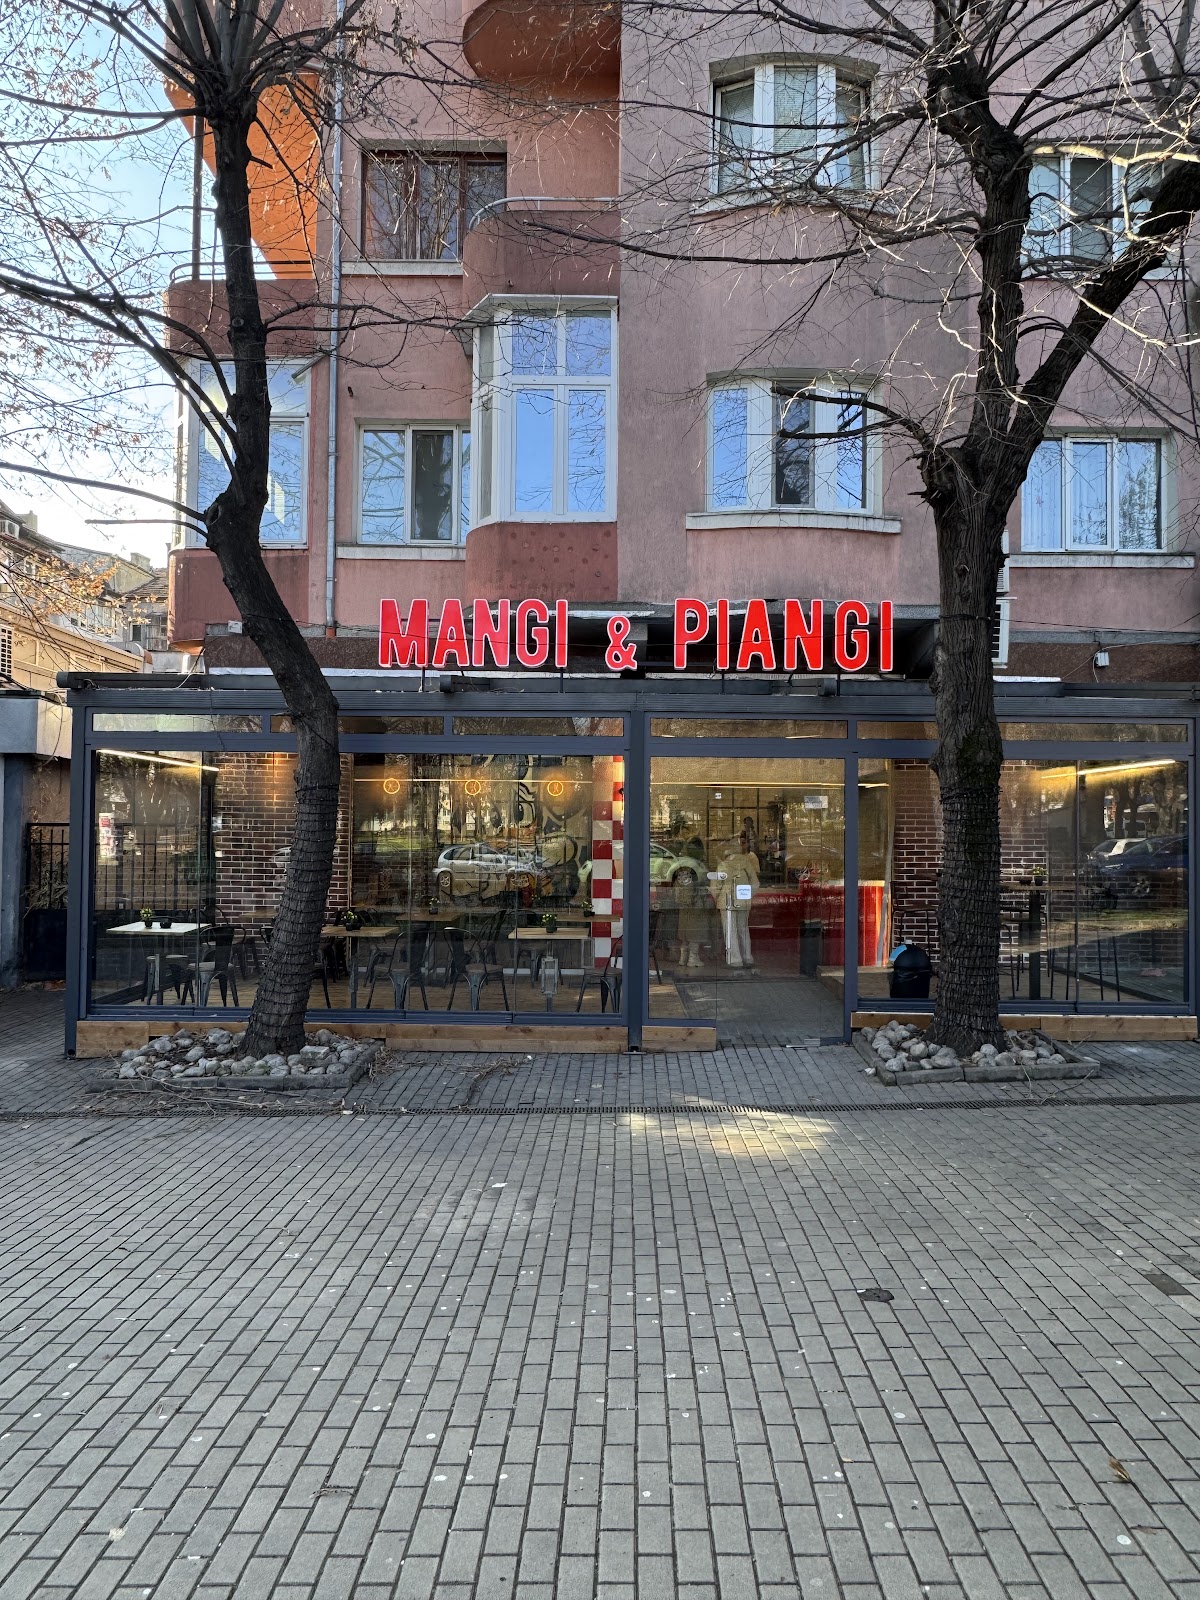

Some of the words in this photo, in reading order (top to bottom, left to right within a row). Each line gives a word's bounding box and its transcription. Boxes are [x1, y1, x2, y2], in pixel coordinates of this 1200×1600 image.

[379, 599, 568, 668] MANGI
[606, 615, 638, 671] &
[674, 598, 894, 672] PIANGI
